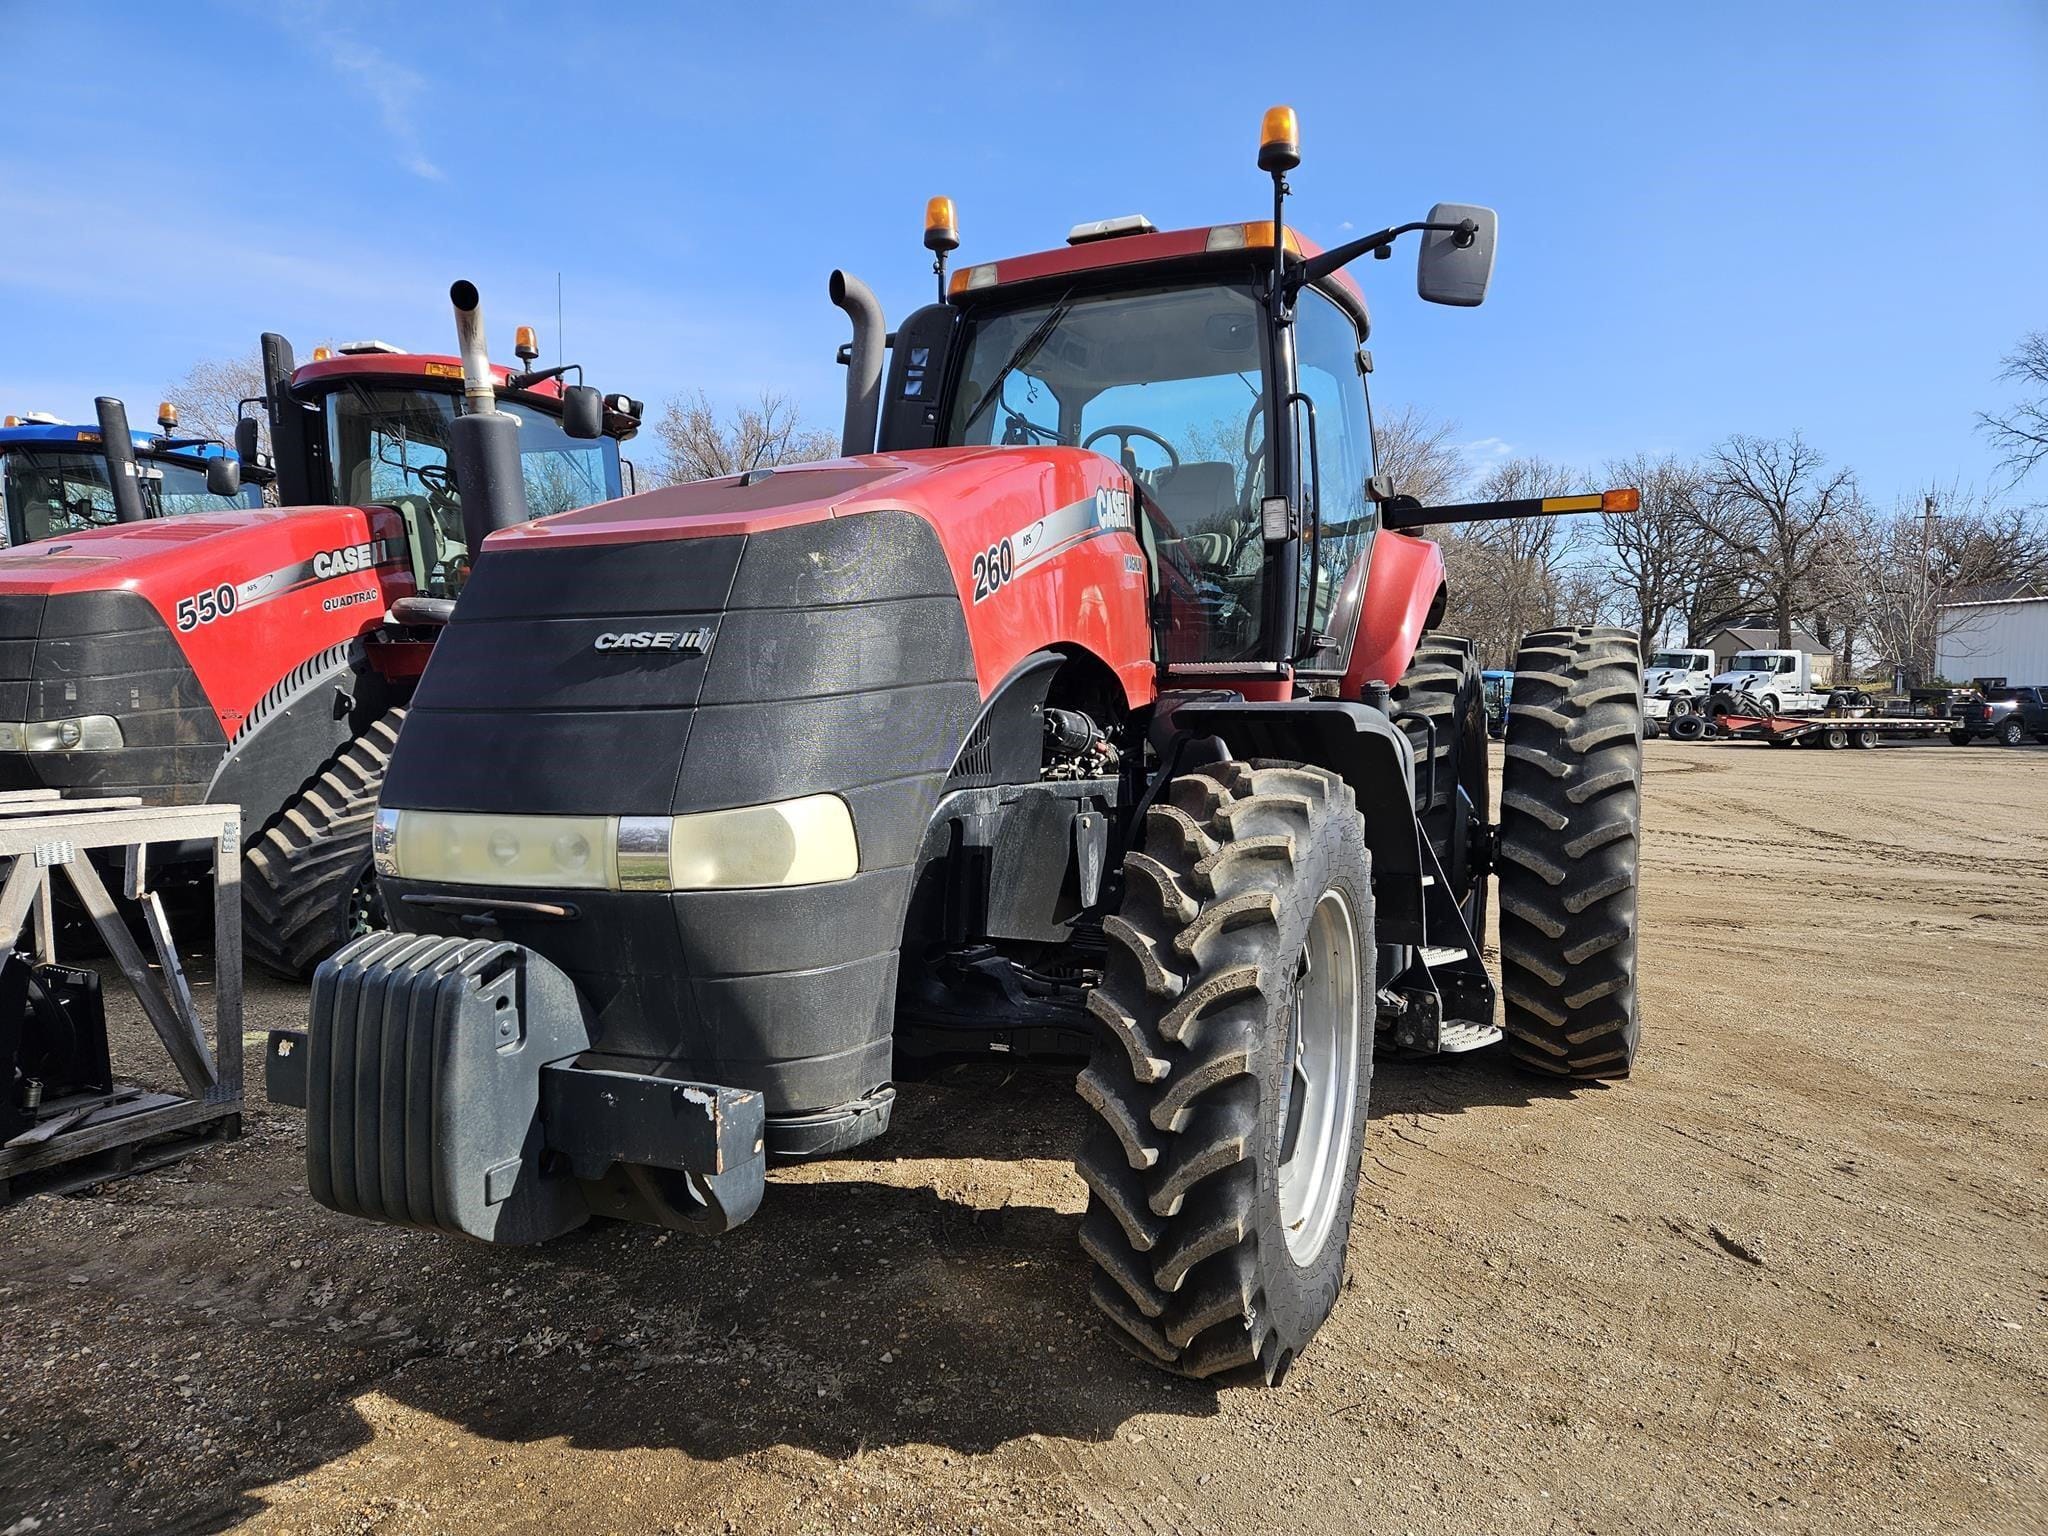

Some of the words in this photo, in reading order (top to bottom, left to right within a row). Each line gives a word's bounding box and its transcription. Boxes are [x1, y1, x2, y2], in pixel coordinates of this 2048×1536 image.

[973, 538, 1013, 605] 260
[1096, 488, 1125, 529] CASE
[177, 583, 236, 632] 550
[313, 544, 371, 579] CASE
[323, 589, 378, 612] QUADTRAC
[594, 631, 678, 649] CASE
